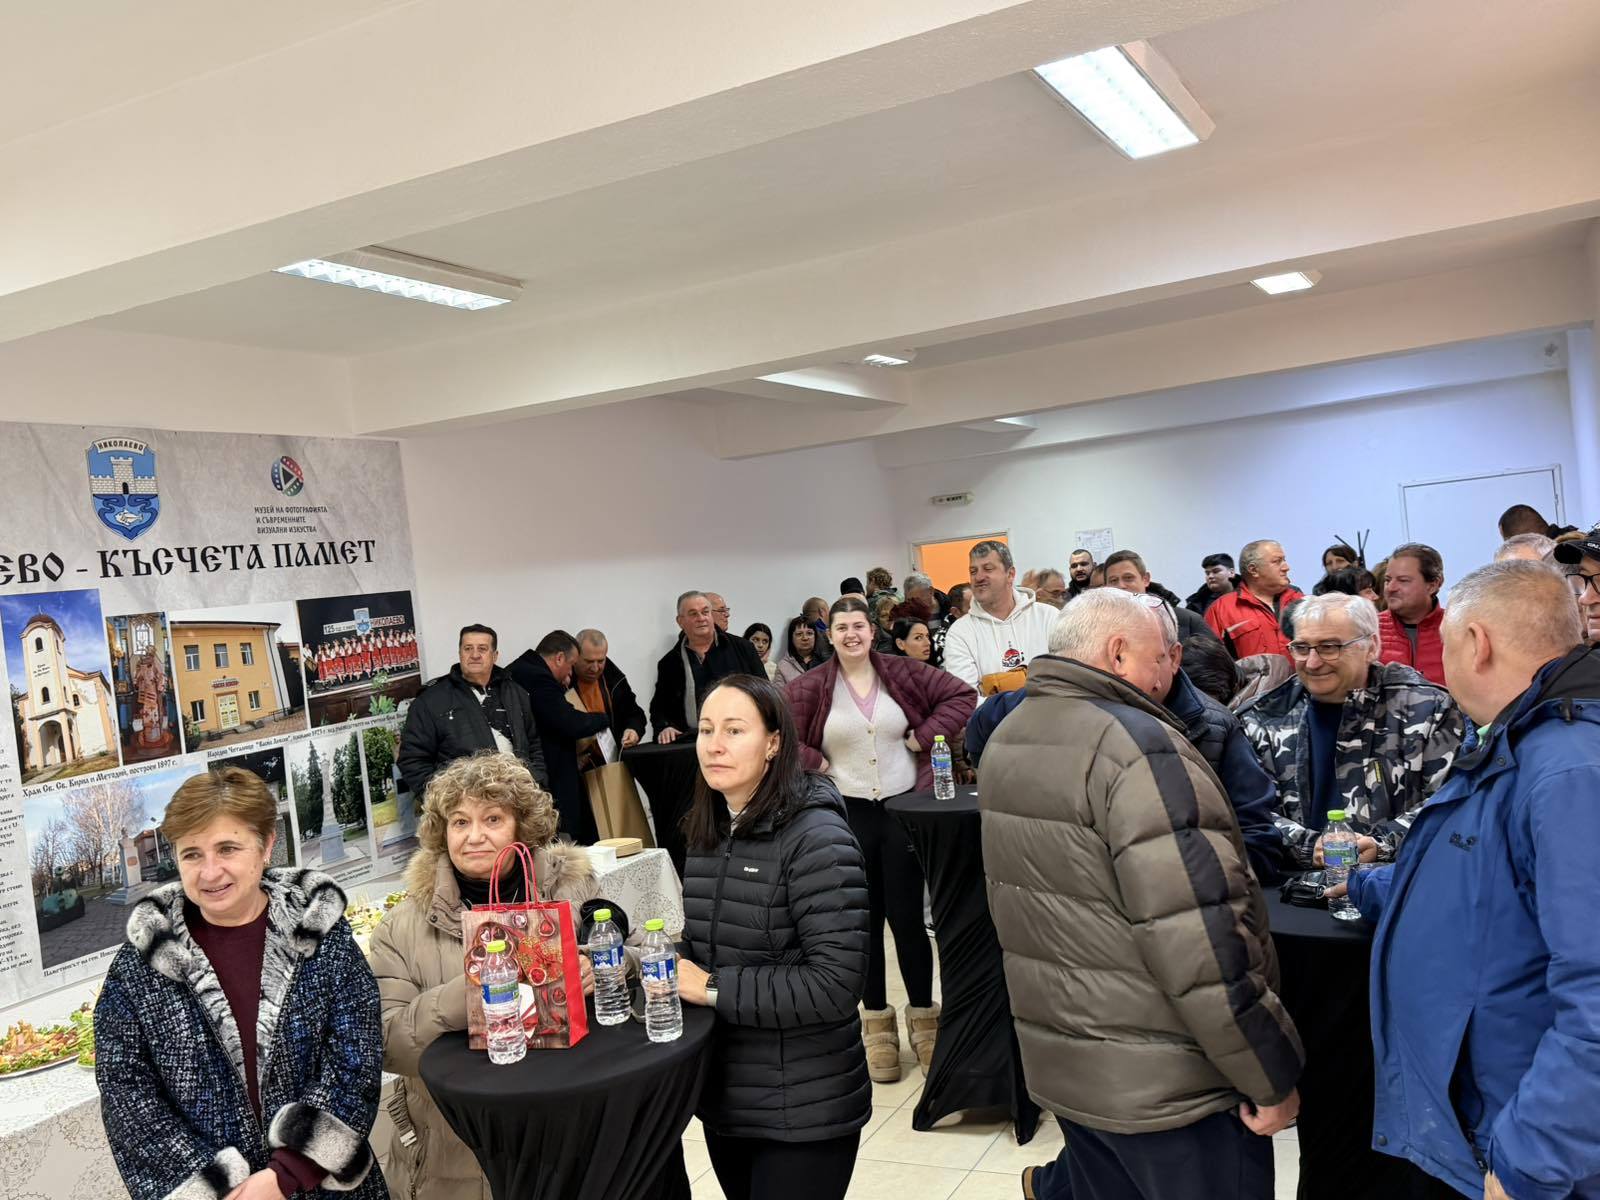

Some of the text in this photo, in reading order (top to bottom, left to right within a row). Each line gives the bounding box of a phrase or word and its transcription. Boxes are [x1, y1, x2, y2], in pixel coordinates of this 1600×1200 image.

[97, 440, 144, 451] НИКОЛАЕВО
[254, 505, 274, 513] МУЗЕЙ
[257, 525, 317, 534] ВИЗУАЛНИ ИЗКУСТВА
[97, 544, 266, 578] КЪСЧЕТА
[272, 540, 375, 568] ПАМЕТ
[22, 788, 41, 798] Храм
[42, 784, 54, 793] Св.
[56, 781, 68, 790] Св.
[69, 778, 89, 787] Кирил
[129, 764, 157, 774] построен
[157, 759, 171, 768] 1897
